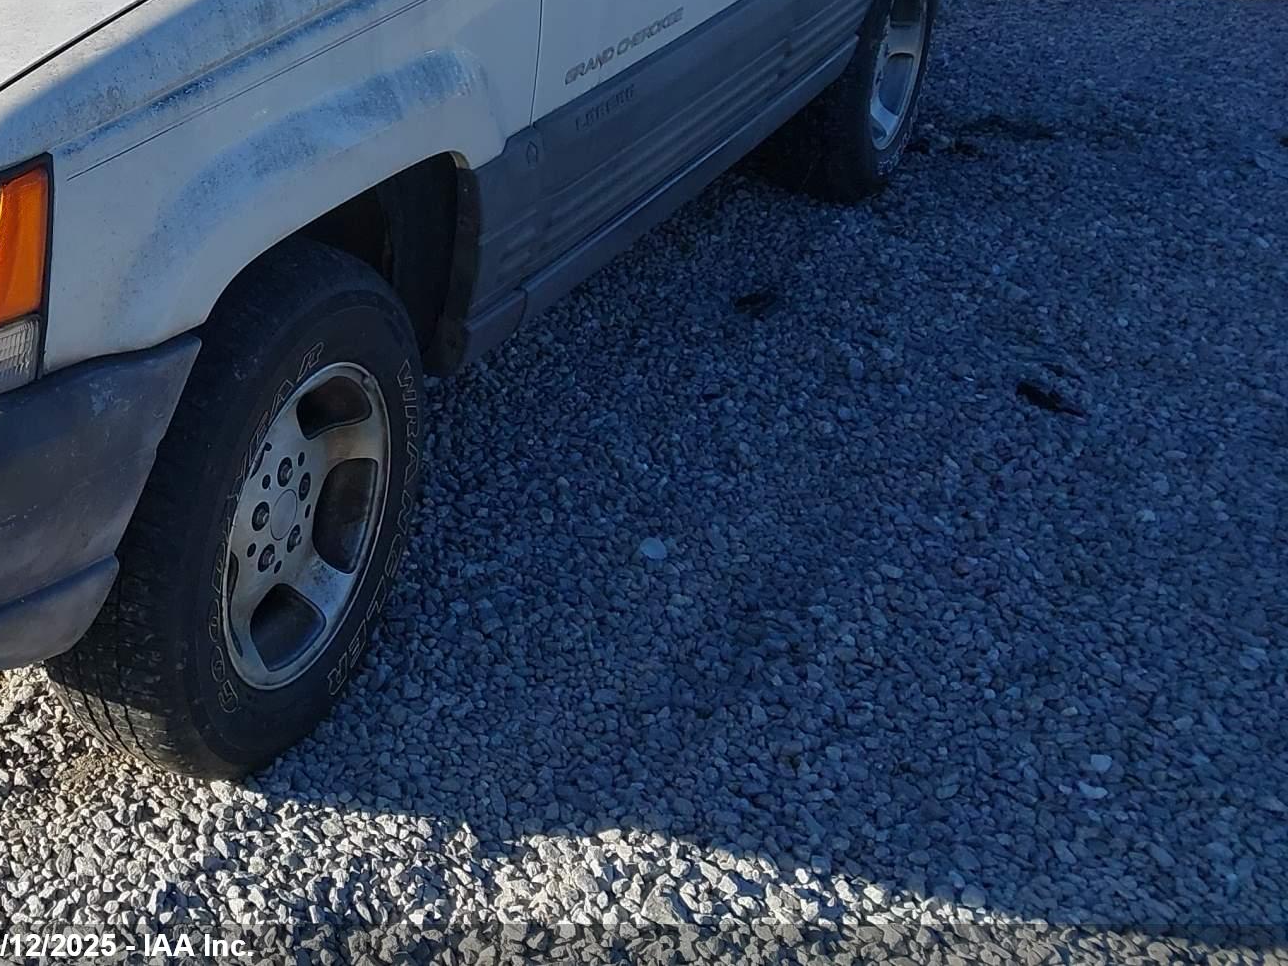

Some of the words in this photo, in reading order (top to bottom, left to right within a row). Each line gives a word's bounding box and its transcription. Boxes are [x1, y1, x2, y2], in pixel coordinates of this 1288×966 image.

[564, 45, 615, 85] GRAND
[617, 7, 684, 55] CHEROKEE
[326, 358, 422, 696] WRANGLER
